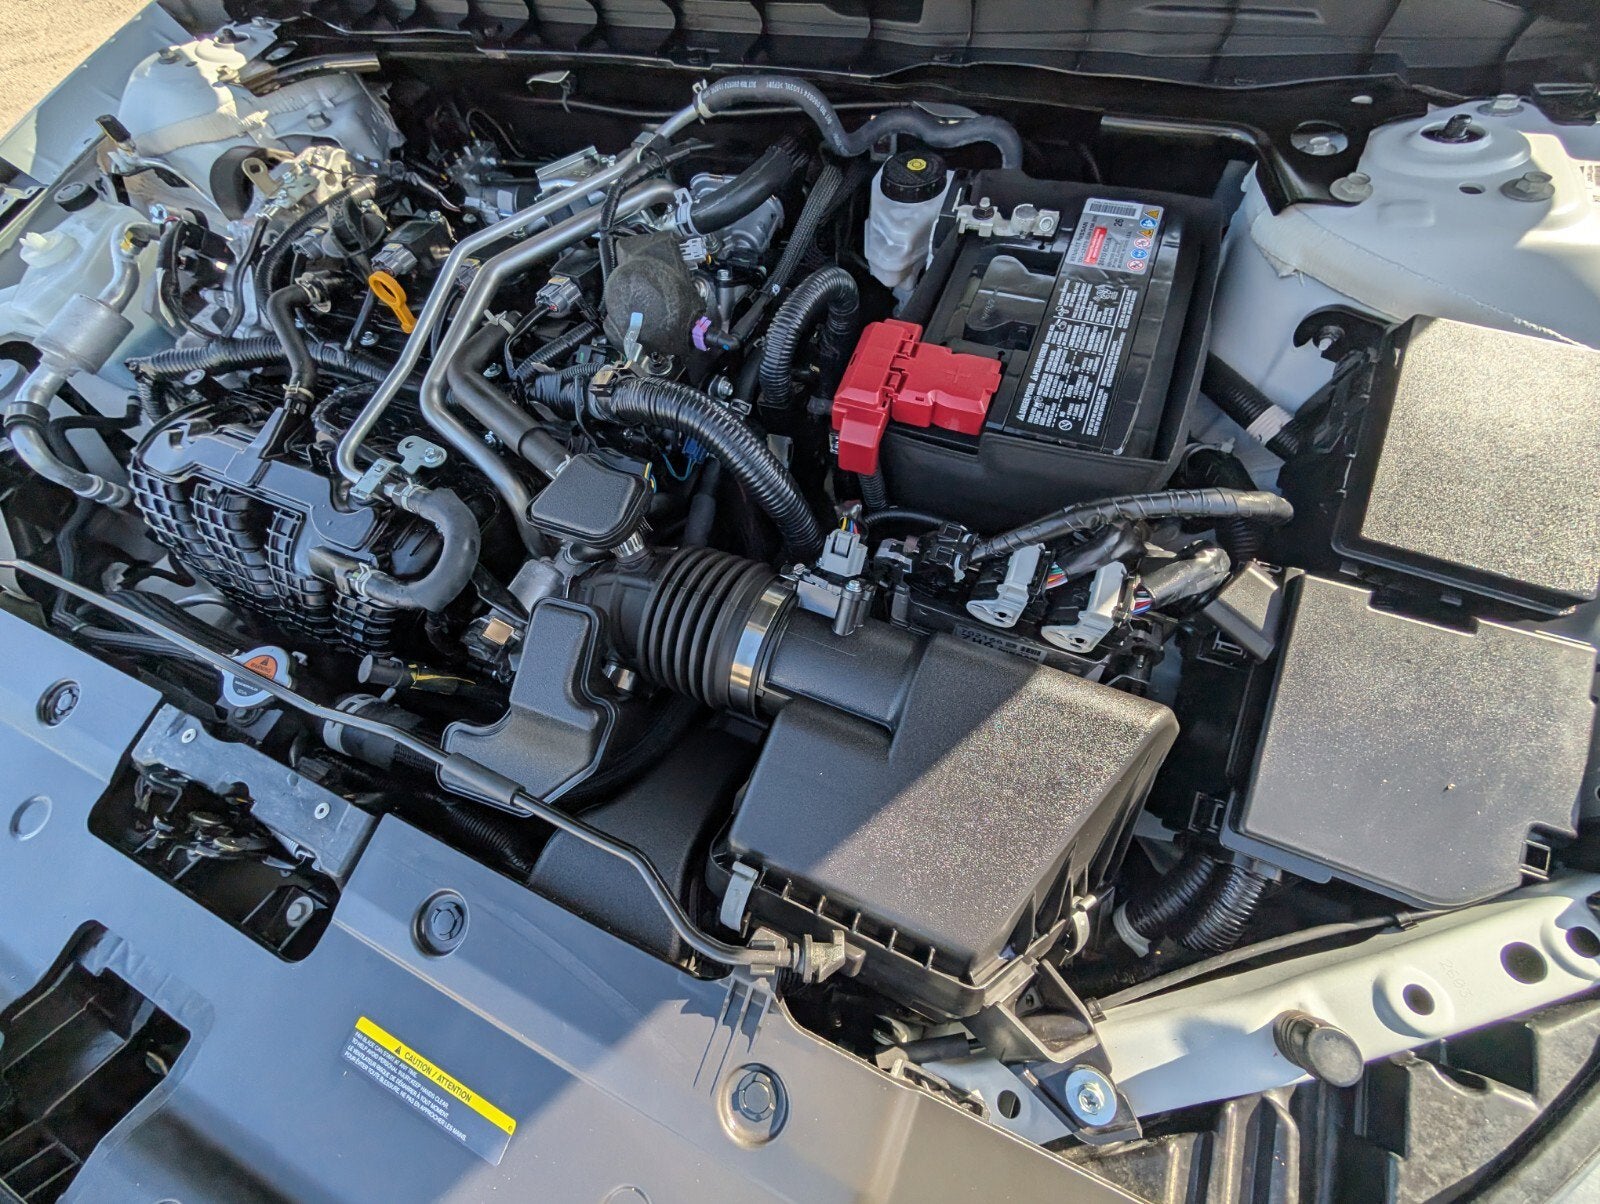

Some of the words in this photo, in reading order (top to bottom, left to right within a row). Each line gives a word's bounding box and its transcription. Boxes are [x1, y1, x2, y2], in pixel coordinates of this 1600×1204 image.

[1113, 218, 1123, 226] 26
[1077, 221, 1088, 240] NISSAN
[374, 1044, 384, 1054] CAN
[404, 1052, 432, 1074] CAUTION
[436, 1074, 472, 1102] ATTENTION
